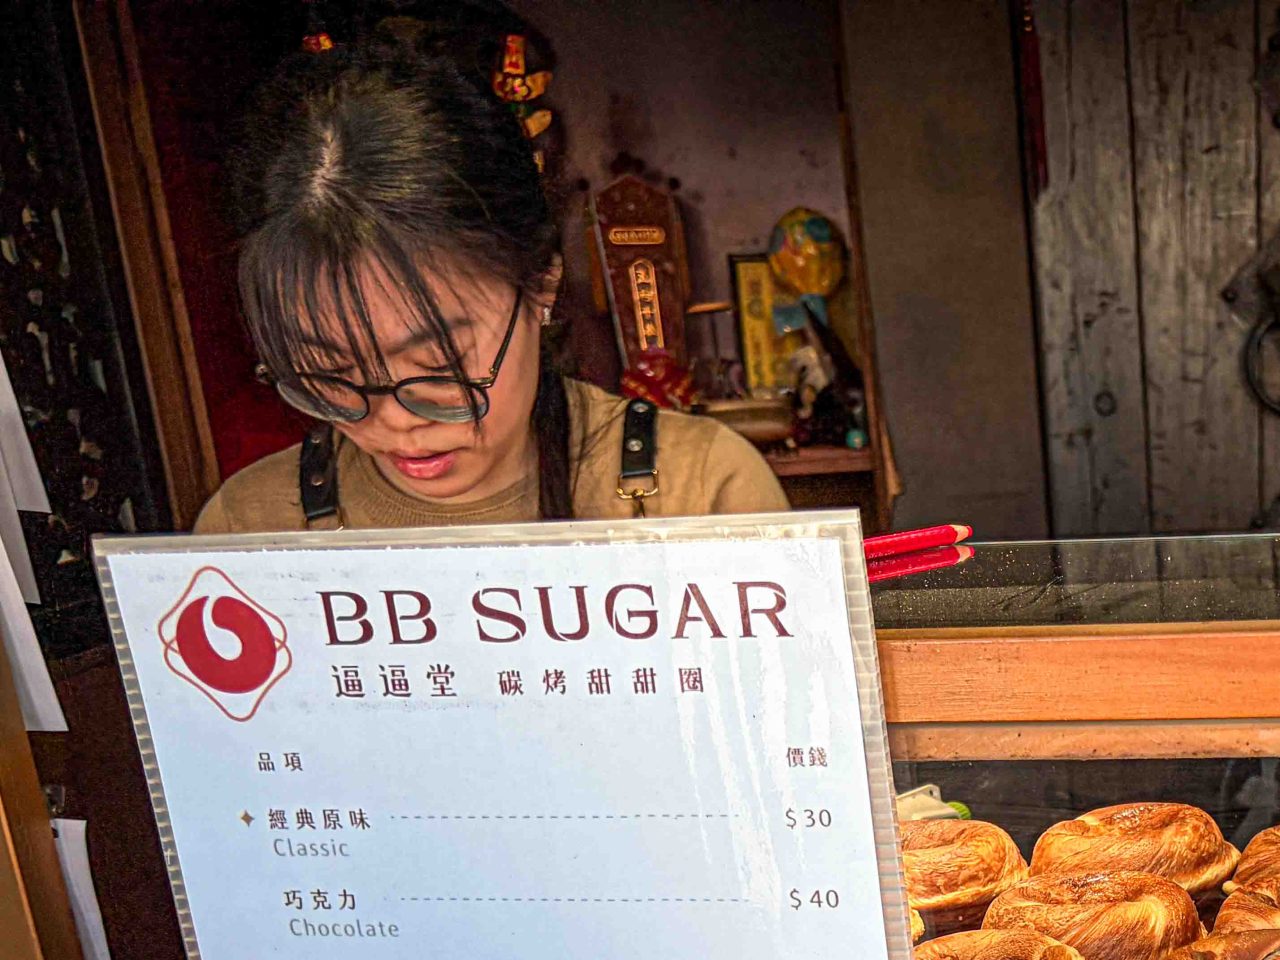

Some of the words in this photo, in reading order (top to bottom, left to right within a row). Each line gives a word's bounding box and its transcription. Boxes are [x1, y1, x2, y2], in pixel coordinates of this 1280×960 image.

[316, 589, 438, 646] BB
[471, 581, 795, 644] SUGAR
[331, 664, 458, 698] 逼逼堂
[497, 667, 705, 695] 碳烤甜甜圈
[257, 751, 305, 773] 品項
[785, 747, 829, 769] 價錢
[267, 807, 372, 831] 經典原味
[273, 838, 351, 859] Classic
[284, 888, 357, 911] 巧克力
[288, 918, 400, 939] Chocolate
